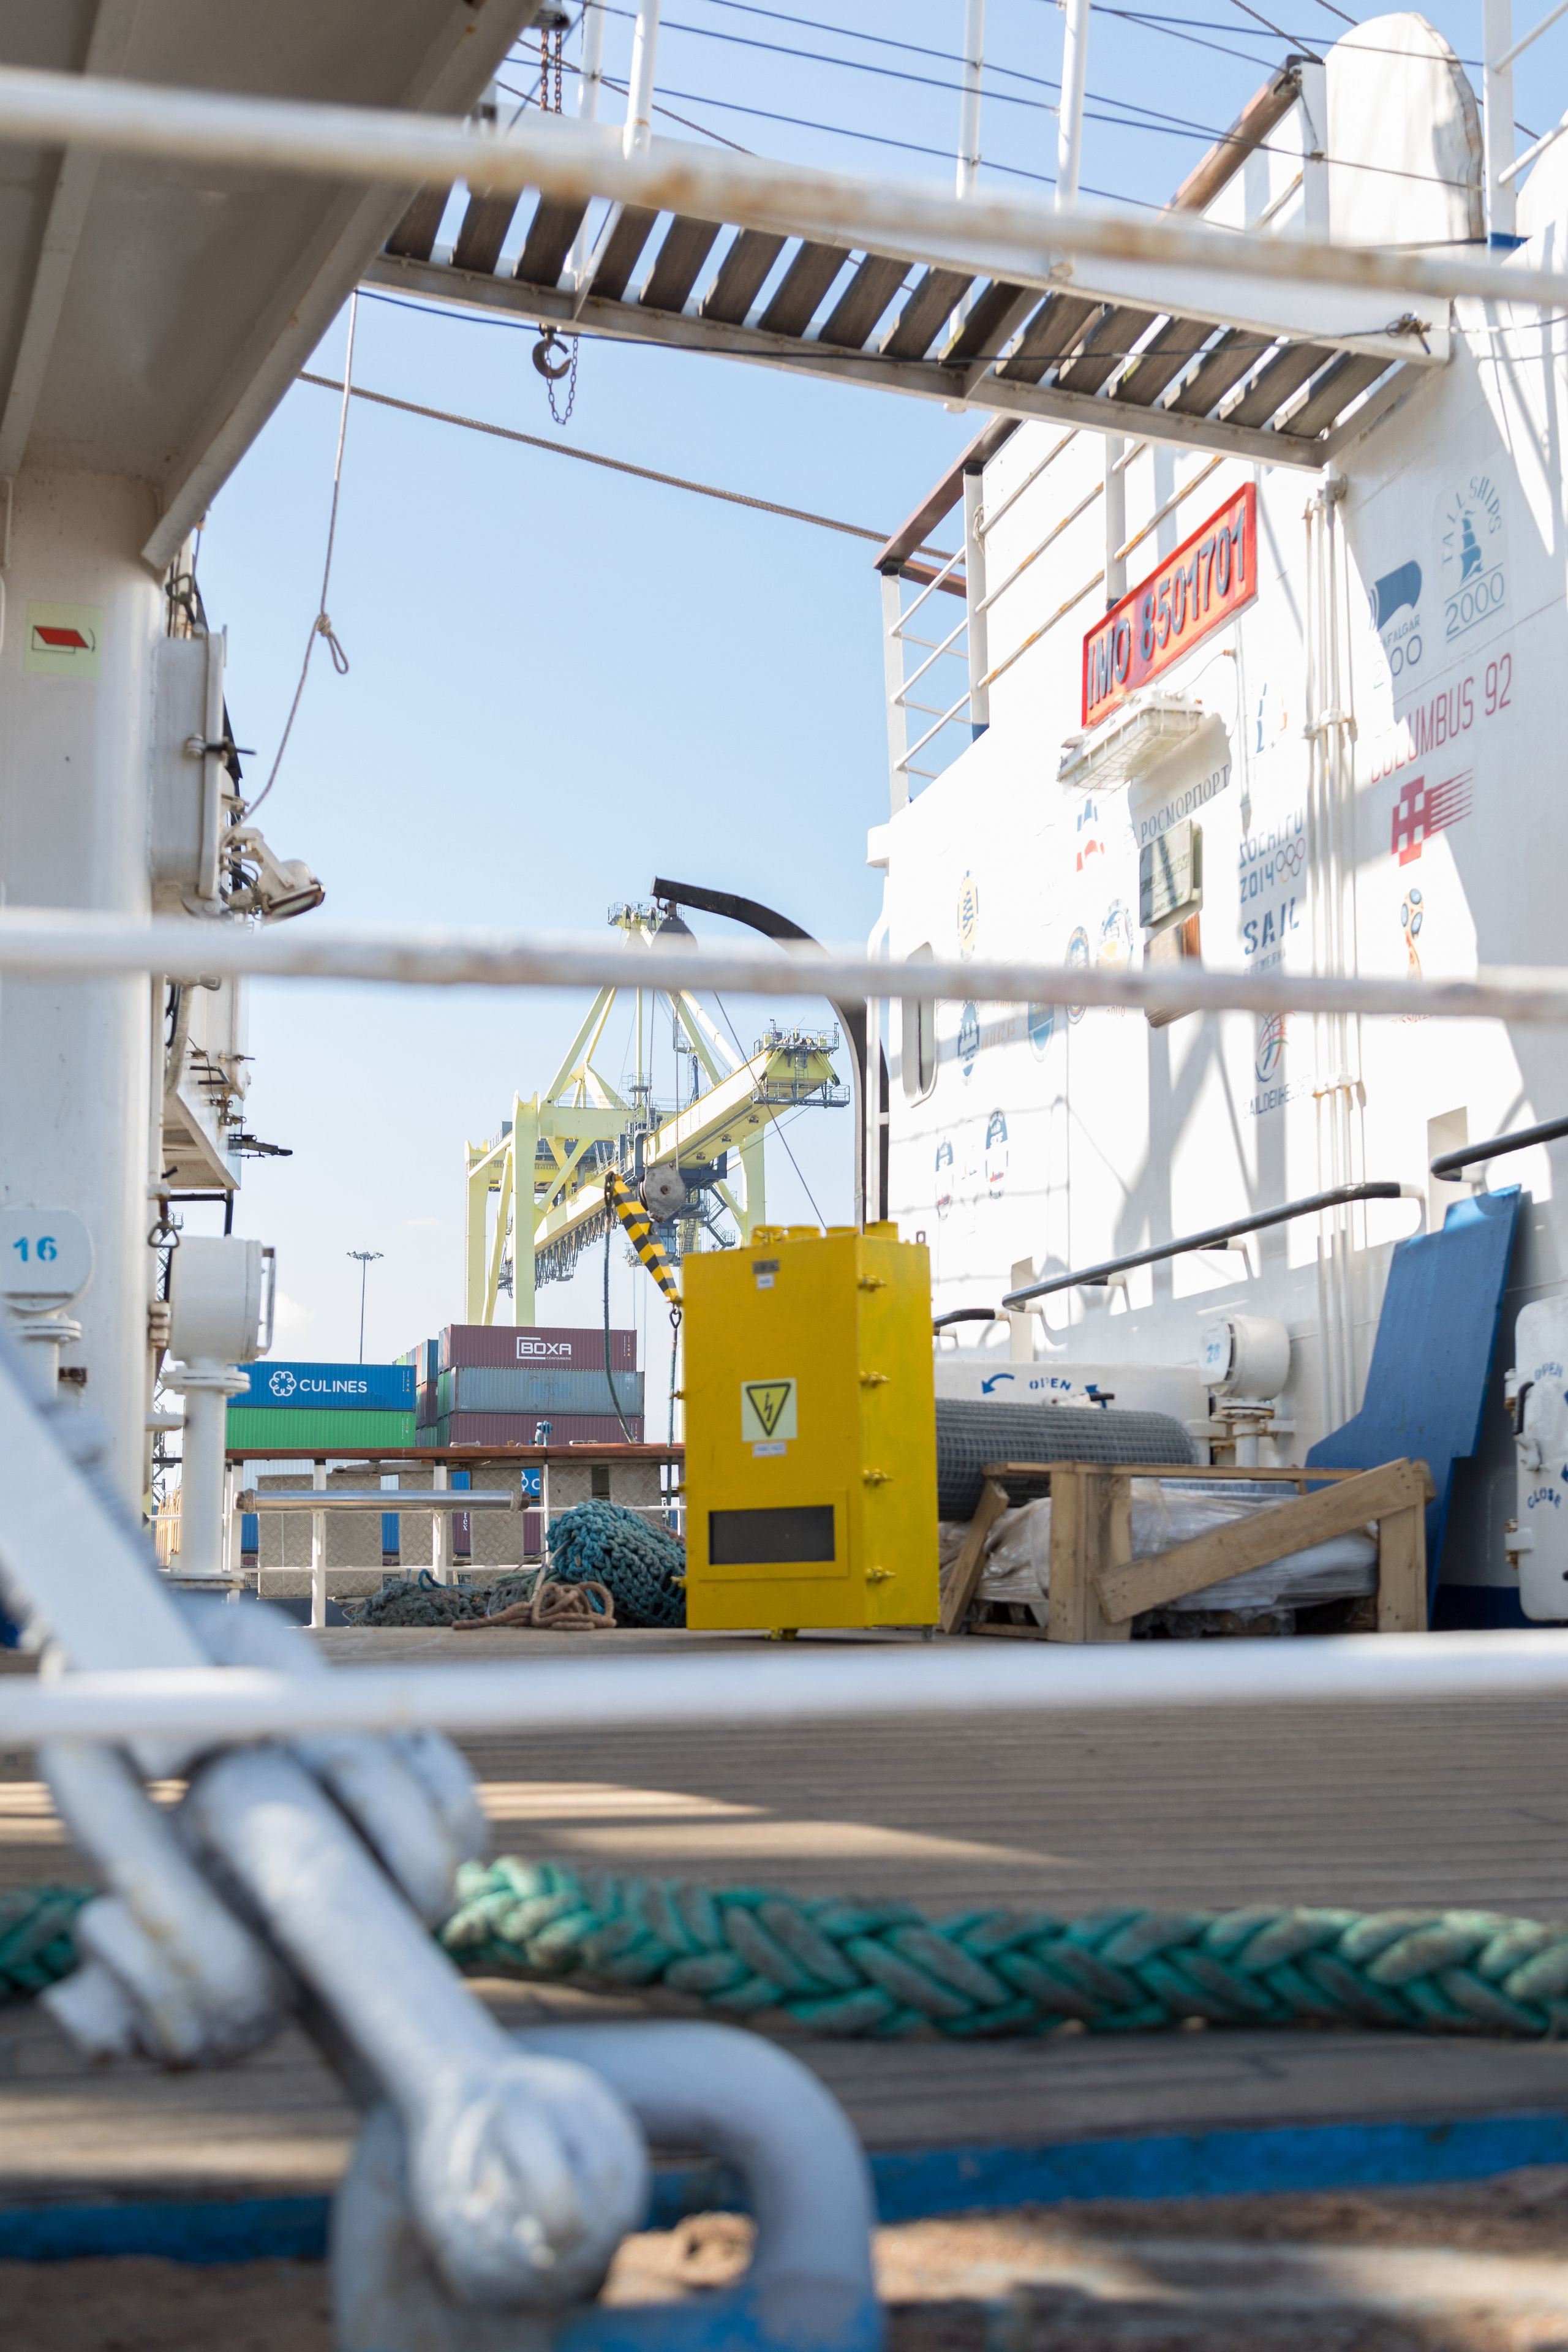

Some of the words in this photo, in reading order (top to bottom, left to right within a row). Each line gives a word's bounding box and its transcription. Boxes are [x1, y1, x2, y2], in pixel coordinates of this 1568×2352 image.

[1442, 492, 1466, 571] TALL
[1470, 476, 1502, 534] SHIPS
[1087, 619, 1131, 710] IMO
[1140, 506, 1246, 662] 8501701
[1446, 571, 1505, 637] 2000
[1378, 614, 1420, 649] AFALGAR
[1485, 652, 1512, 717] 92
[1140, 764, 1229, 845] РОСМОРПОРТ
[1240, 860, 1275, 905] 2014
[1243, 896, 1300, 956] SAIL
[13, 1235, 58, 1262] 16
[521, 1342, 572, 1355] BOXA
[300, 1379, 368, 1393] CULINES
[1028, 1377, 1072, 1392] OPEN
[1534, 1361, 1563, 1381] OPEN
[1527, 1487, 1561, 1509] CLOSE
